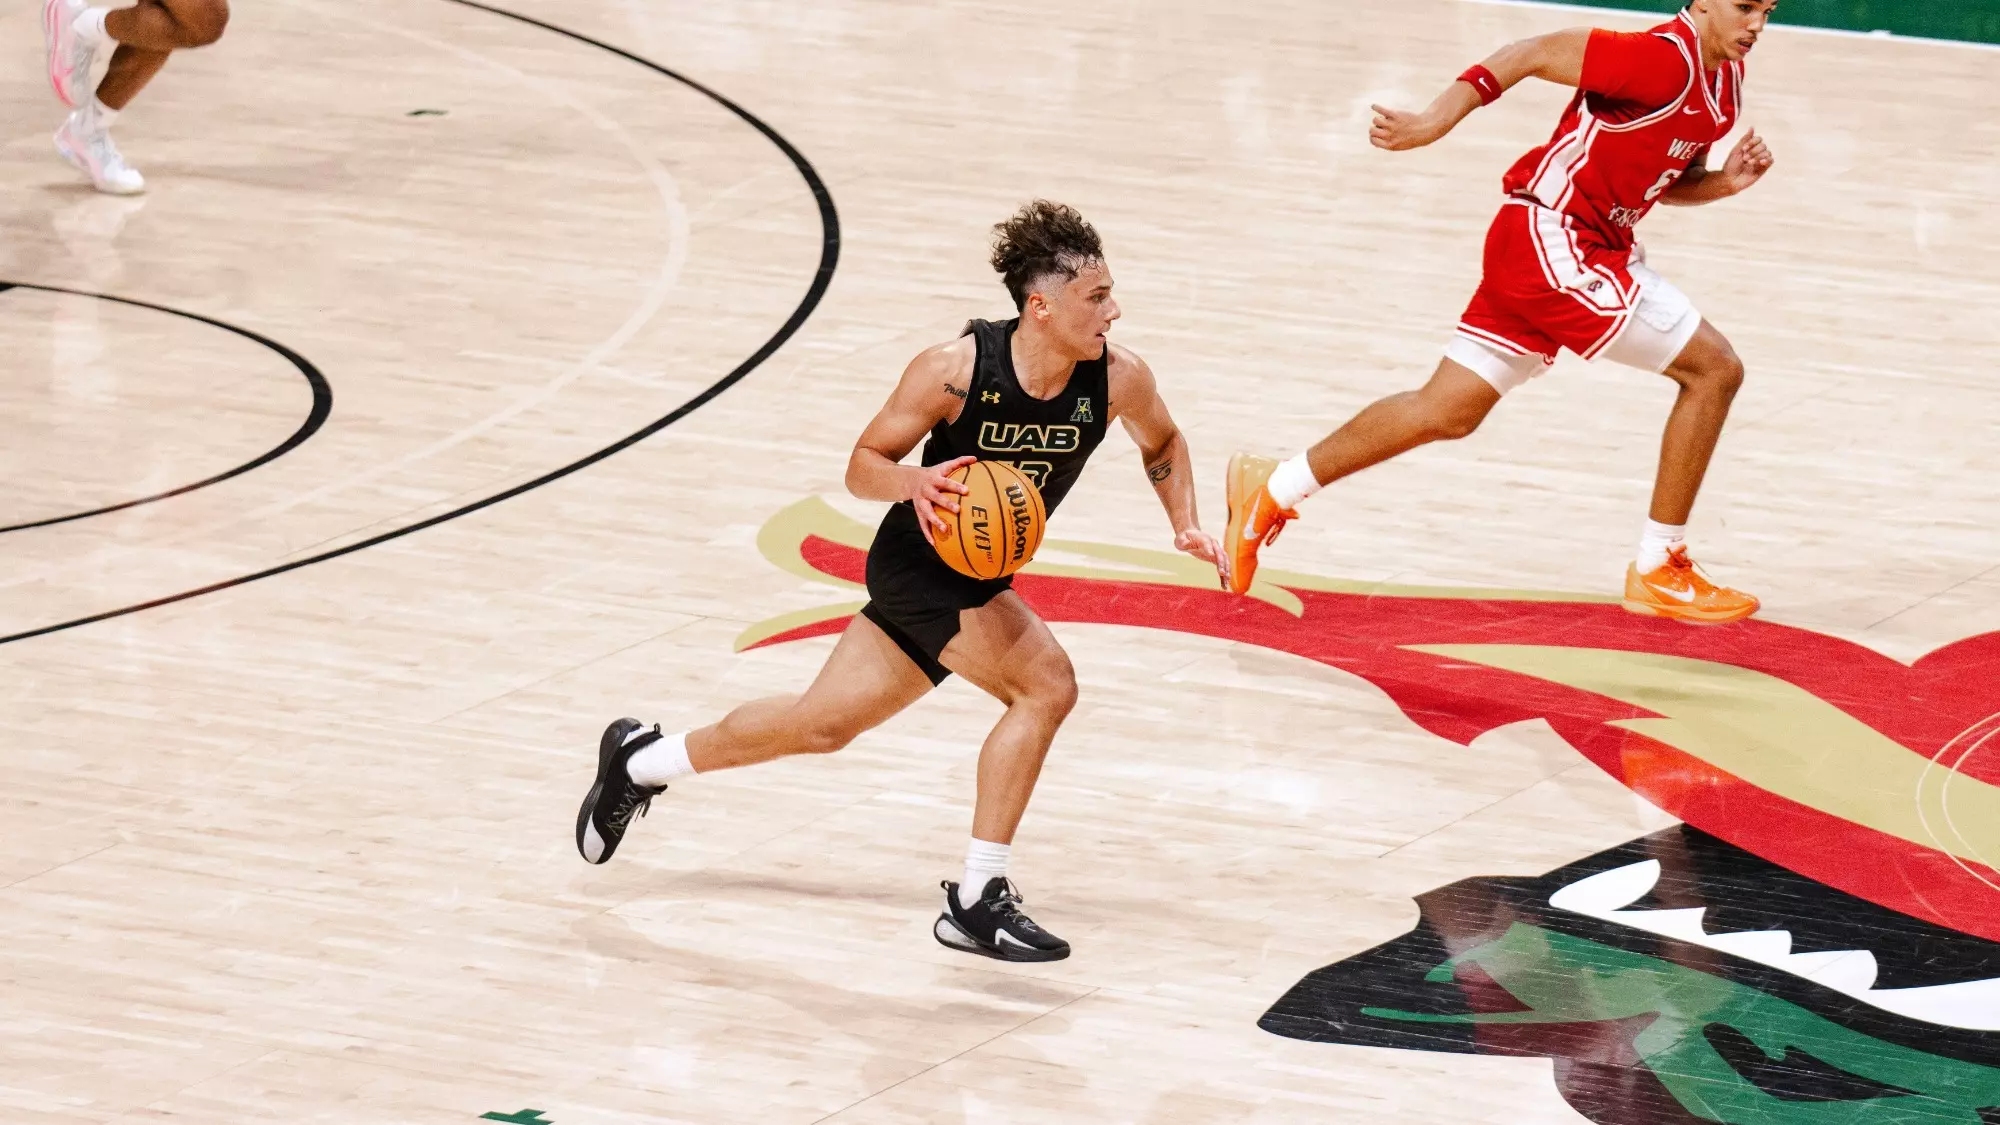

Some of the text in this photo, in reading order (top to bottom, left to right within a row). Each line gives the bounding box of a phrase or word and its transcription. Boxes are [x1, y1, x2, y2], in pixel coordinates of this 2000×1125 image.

[978, 421, 1080, 453] UAB
[971, 505, 992, 551] EVO
[1005, 481, 1031, 561] Wilson
